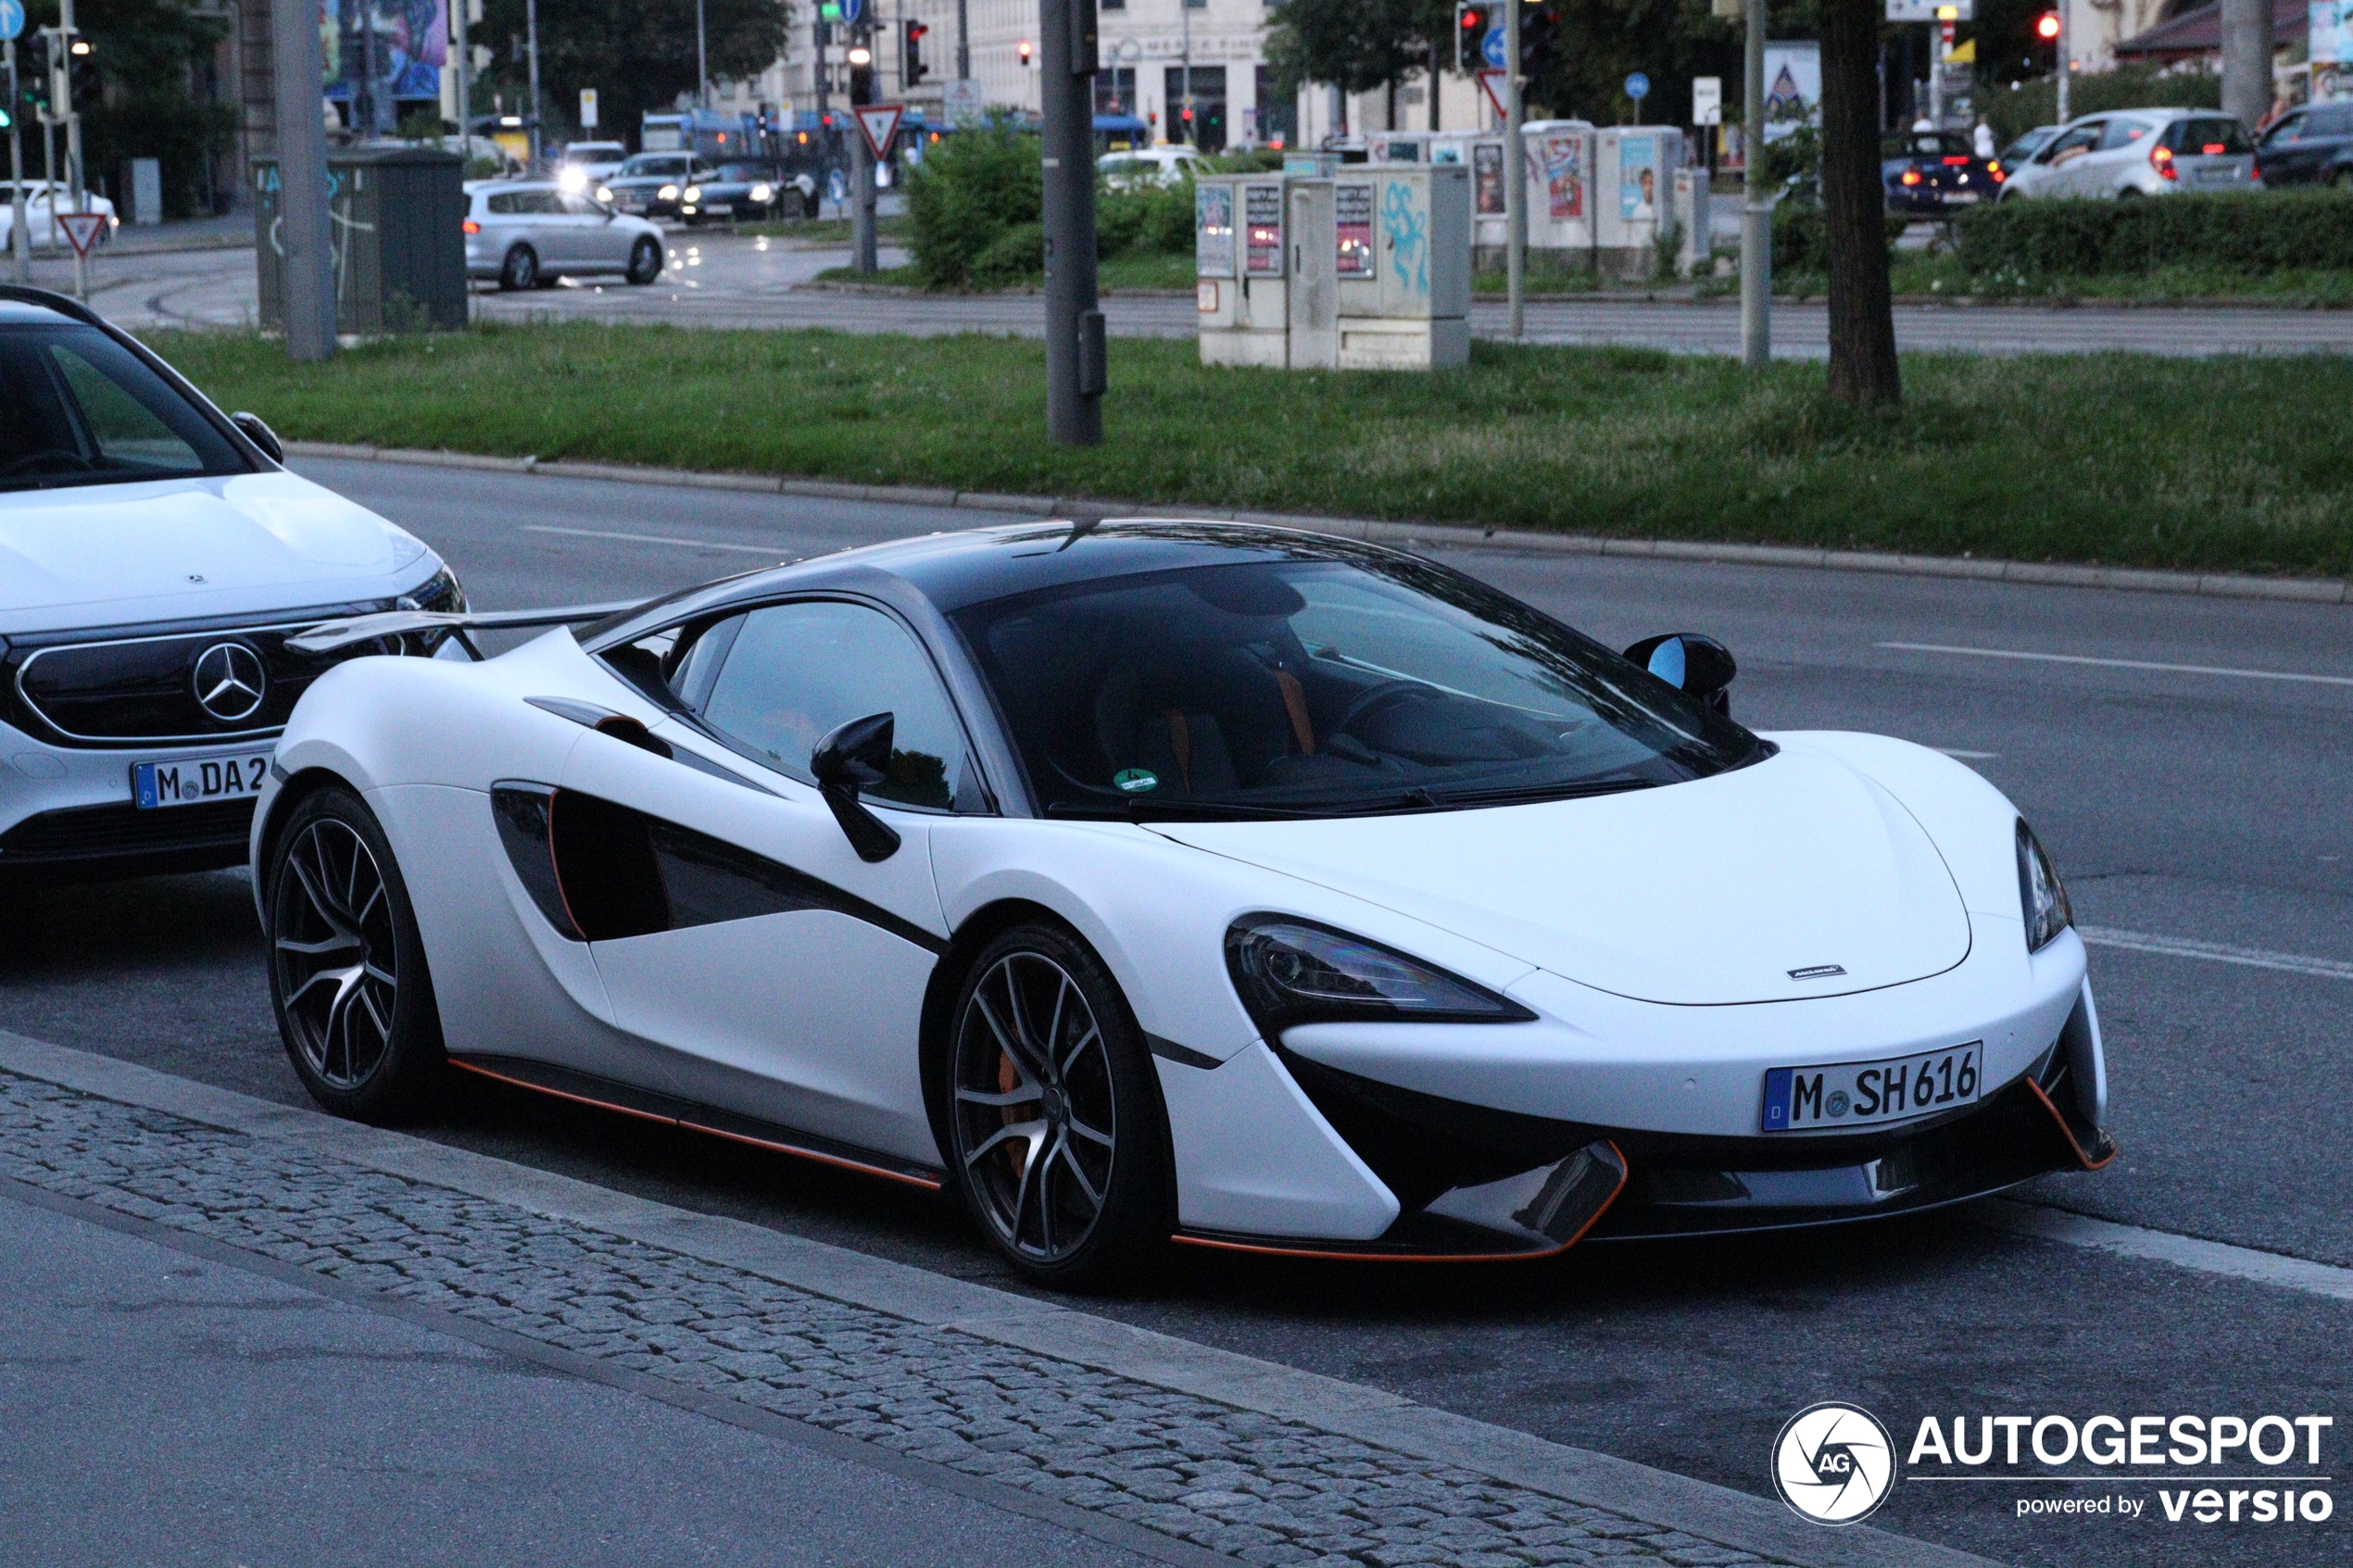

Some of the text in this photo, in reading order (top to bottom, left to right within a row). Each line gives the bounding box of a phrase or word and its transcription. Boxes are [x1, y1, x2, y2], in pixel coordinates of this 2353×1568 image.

[157, 767, 180, 801] M
[1794, 966, 1838, 977] McLaren
[1793, 1073, 1823, 1122] M
